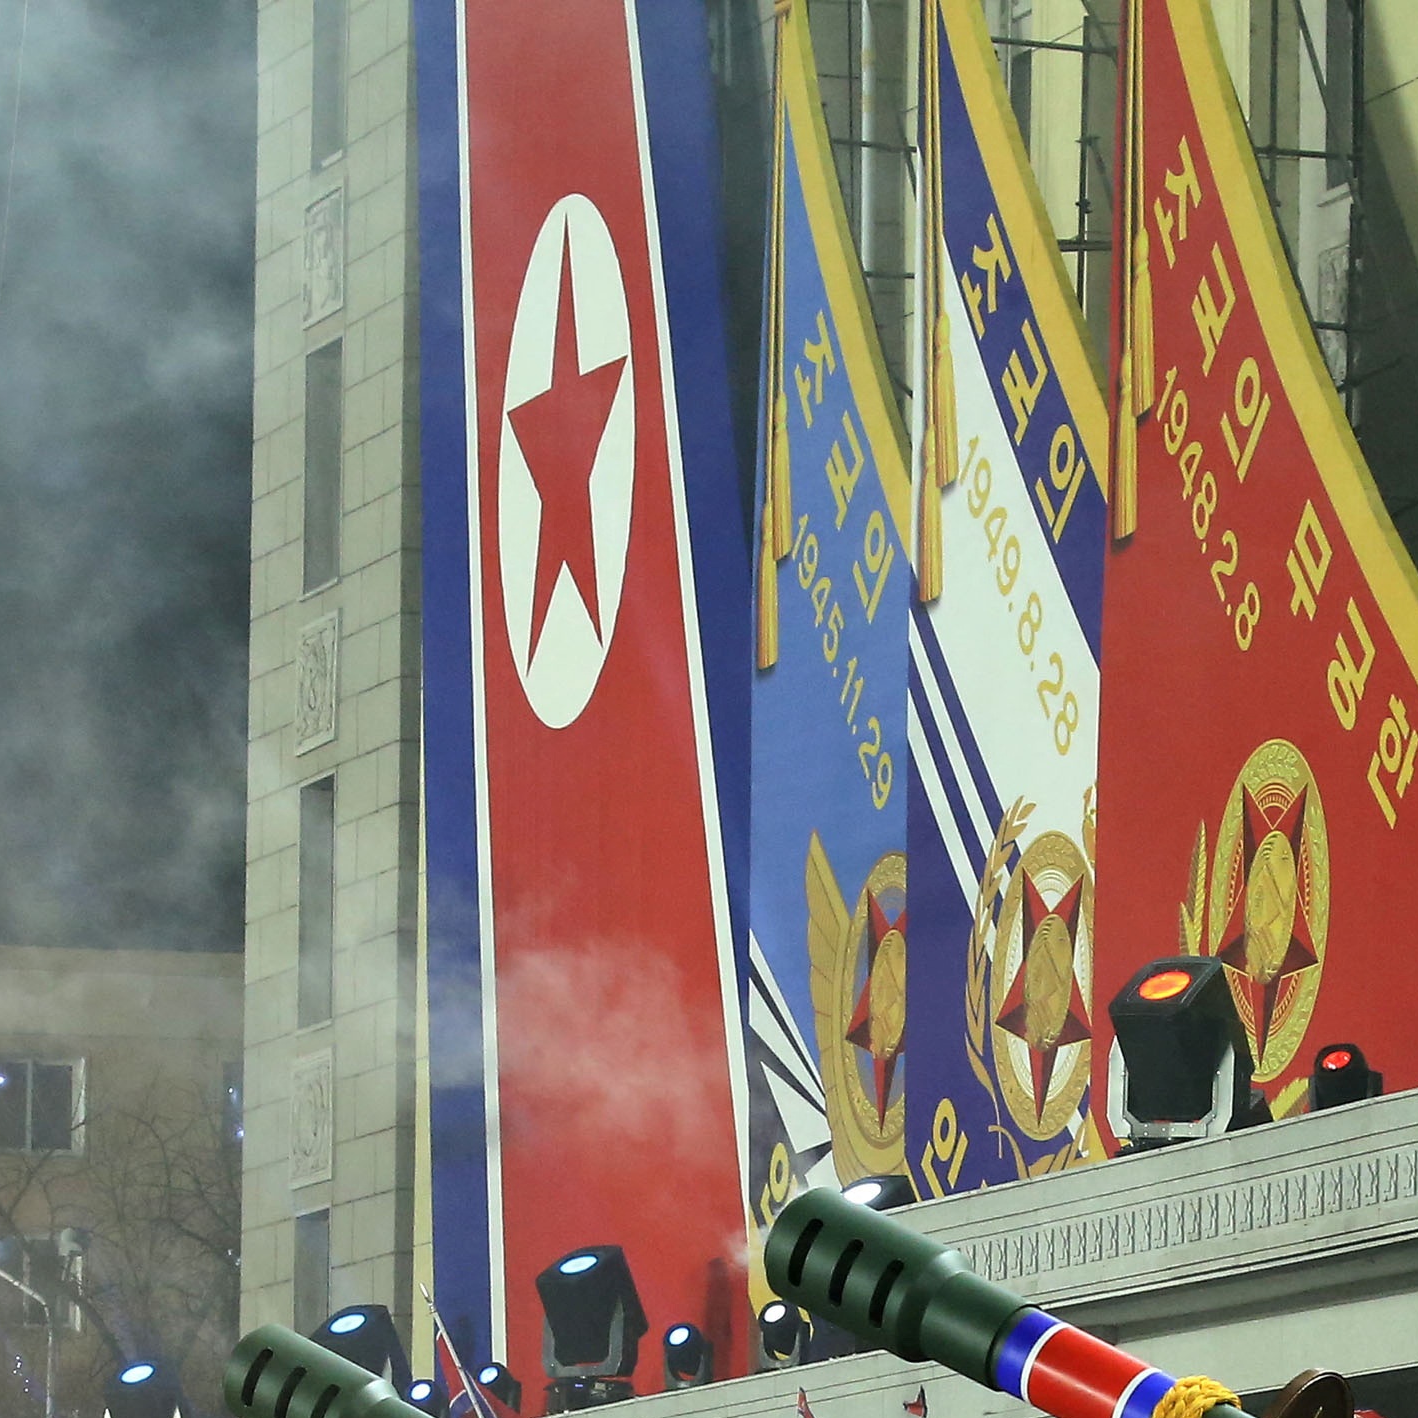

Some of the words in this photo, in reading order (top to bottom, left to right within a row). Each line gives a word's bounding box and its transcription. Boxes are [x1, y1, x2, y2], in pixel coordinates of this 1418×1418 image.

[961, 213, 1086, 544] 조국의
[1154, 134, 1272, 485] 조국의
[794, 313, 895, 625] 조국의
[959, 434, 1080, 757] 1949.8.28
[1155, 365, 1261, 652] 1948.2.8
[792, 513, 894, 811] 1945.11.29
